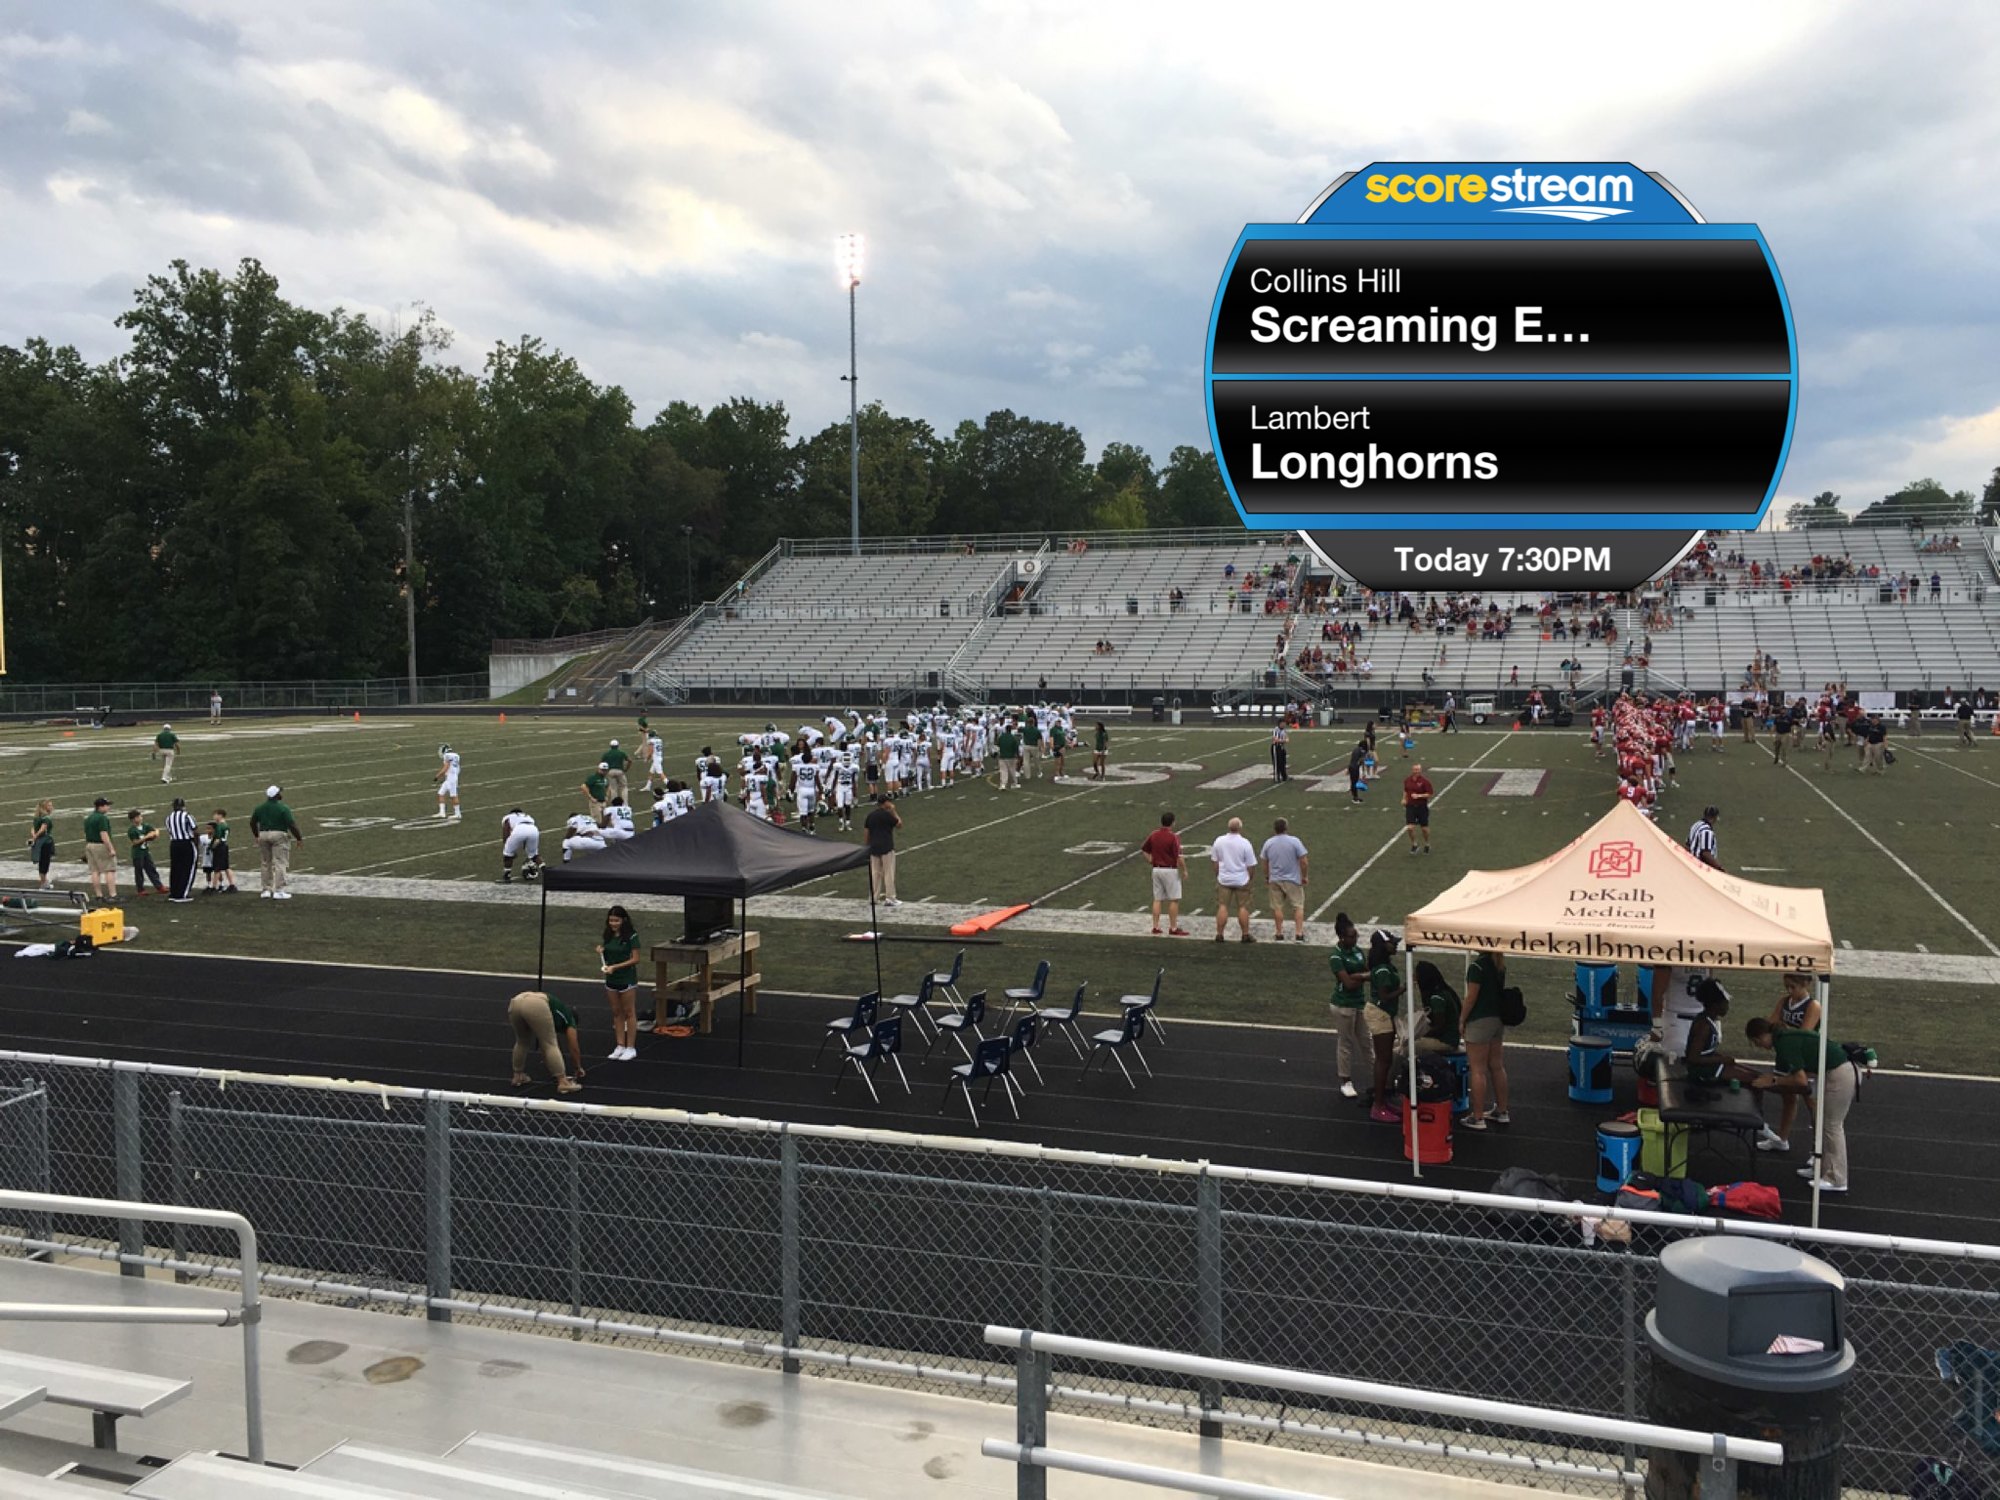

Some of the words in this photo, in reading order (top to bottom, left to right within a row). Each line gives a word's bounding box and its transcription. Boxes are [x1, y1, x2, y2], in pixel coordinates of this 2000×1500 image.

[1569, 888, 1654, 902] DeKalb
[1563, 905, 1655, 919] Medical
[1420, 930, 1817, 973] wwwdekalbmedicalorg
